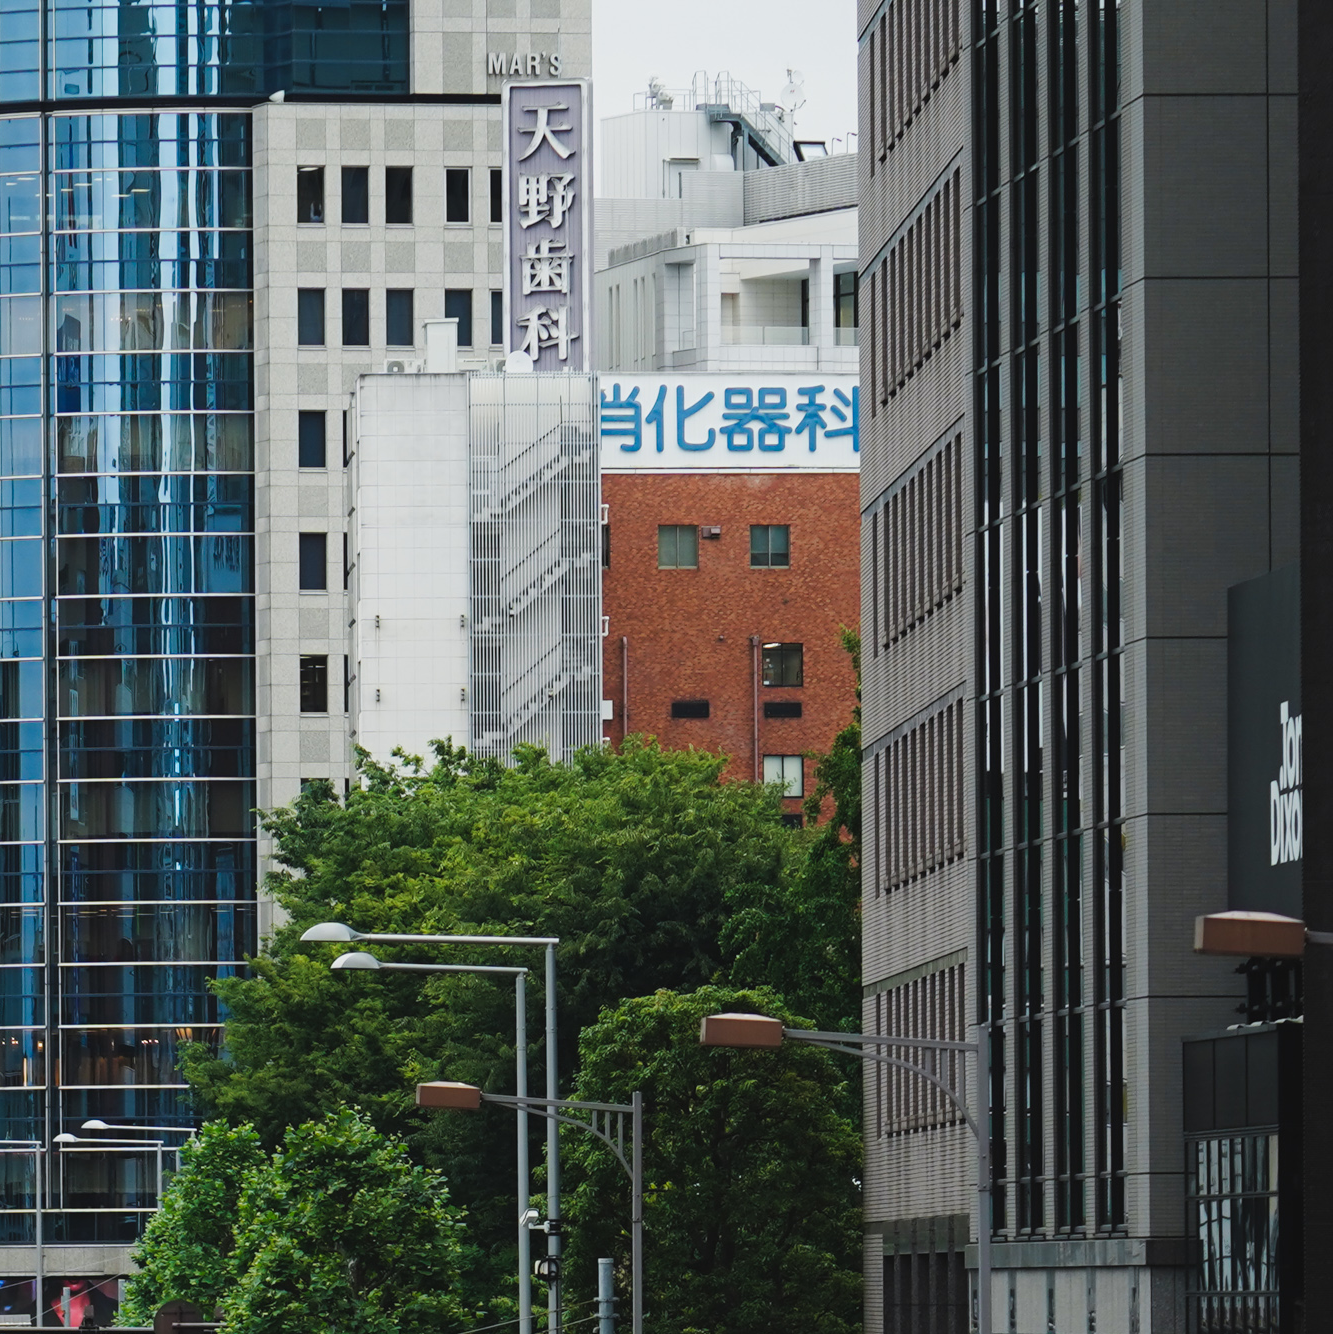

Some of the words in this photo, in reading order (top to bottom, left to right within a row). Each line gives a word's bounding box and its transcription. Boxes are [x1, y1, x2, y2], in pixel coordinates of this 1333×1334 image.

[488, 52, 563, 77] MAR'S
[517, 103, 579, 362] 天野歯科
